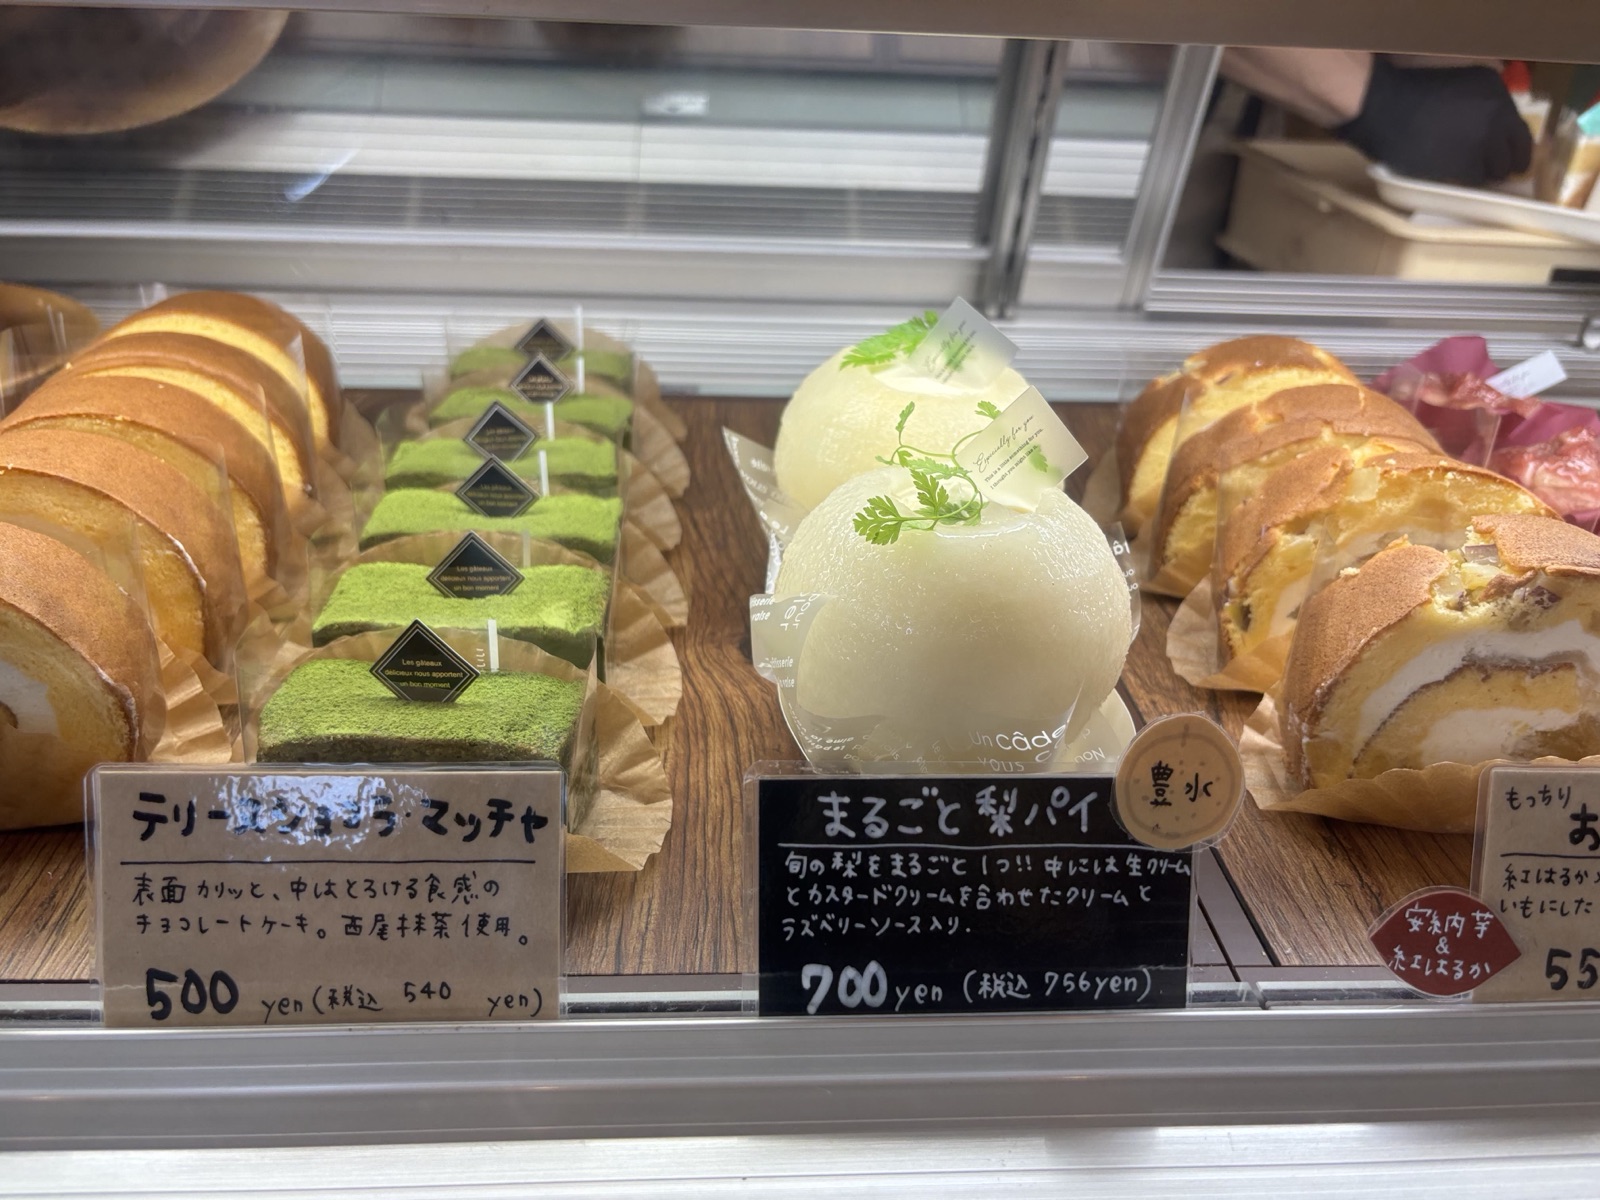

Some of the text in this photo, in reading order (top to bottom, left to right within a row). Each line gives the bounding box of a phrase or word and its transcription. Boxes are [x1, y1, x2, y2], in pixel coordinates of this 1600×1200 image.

[973, 415, 1034, 473] Especially for you
[1149, 760, 1214, 807] 豊水
[1505, 784, 1572, 810] もっちり
[1405, 902, 1494, 939] 安納芋
[1389, 945, 1490, 980] 紅はるか
[1436, 936, 1450, 954] &
[145, 968, 239, 1020] 500
[404, 980, 451, 1001] 540
[487, 987, 544, 1017] yen)
[801, 960, 888, 1015] 700
[895, 981, 943, 1008] yen
[963, 969, 1031, 1004] (税込
